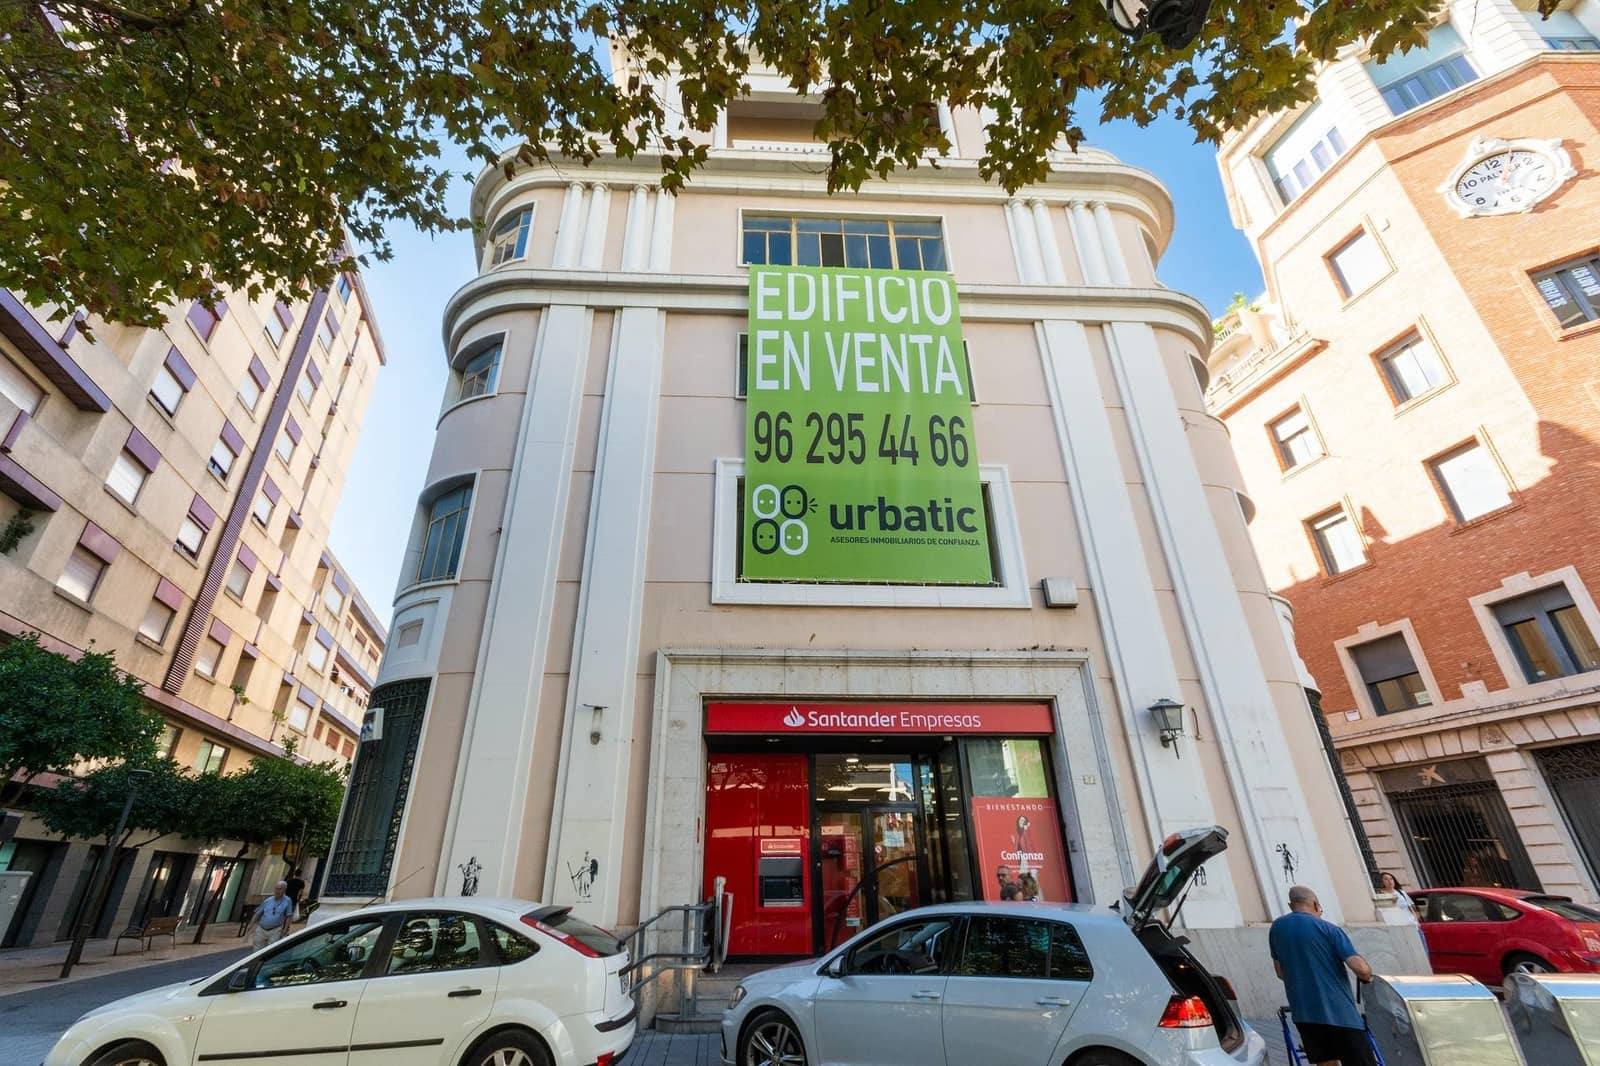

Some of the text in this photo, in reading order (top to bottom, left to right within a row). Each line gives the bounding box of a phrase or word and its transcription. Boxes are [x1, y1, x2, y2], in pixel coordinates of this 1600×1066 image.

[1479, 162, 1521, 184] PALER
[1484, 159, 1502, 171] 12
[1463, 178, 1478, 190] 10
[1474, 196, 1487, 206] 8
[756, 271, 951, 326] EDIFICIO
[756, 329, 964, 396] EN VENTA
[754, 411, 969, 468] 96 295 44 66
[829, 496, 979, 534] urbatic
[830, 536, 980, 546] ASESORES INMOBILIARIOS DE CONFIANZA
[808, 710, 982, 731] Santander Empresas
[985, 803, 1044, 811] BIENESTANDO
[1000, 850, 1044, 861] Confianza
